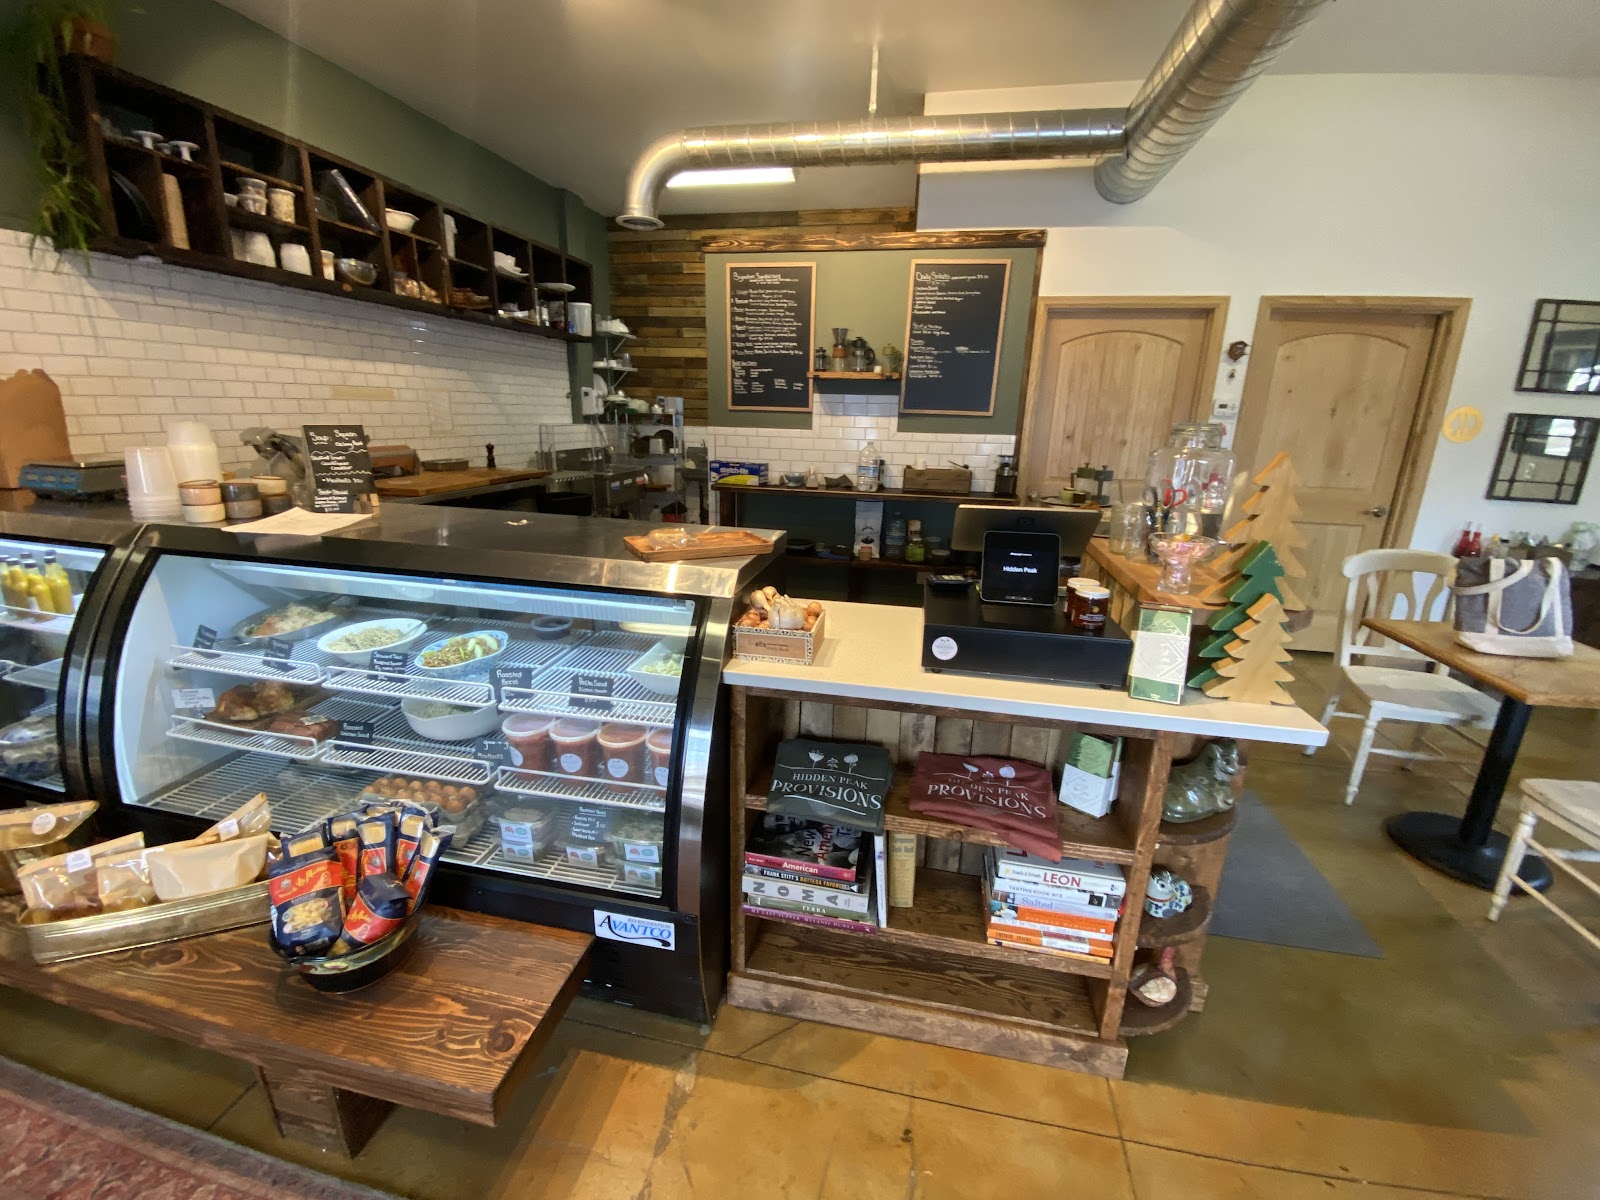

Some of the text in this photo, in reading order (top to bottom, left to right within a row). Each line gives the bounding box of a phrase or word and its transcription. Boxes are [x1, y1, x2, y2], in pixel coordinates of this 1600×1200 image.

[1002, 565, 1038, 574] Hidden Peak
[496, 669, 523, 678] Roasted
[593, 679, 608, 687] Salad
[793, 773, 868, 790] HIDDEN PEAK
[770, 779, 882, 810] PROVISIONS
[927, 784, 1047, 818] PROVISIONS
[782, 862, 819, 874] American
[763, 869, 780, 878] FRANK
[780, 873, 800, 881] STITT'S
[1043, 872, 1082, 888] LEON
[1009, 885, 1033, 893] TARTINE
[1021, 895, 1054, 909] Salted
[801, 905, 827, 913] TERRA
[597, 914, 672, 940] AVANTCO
